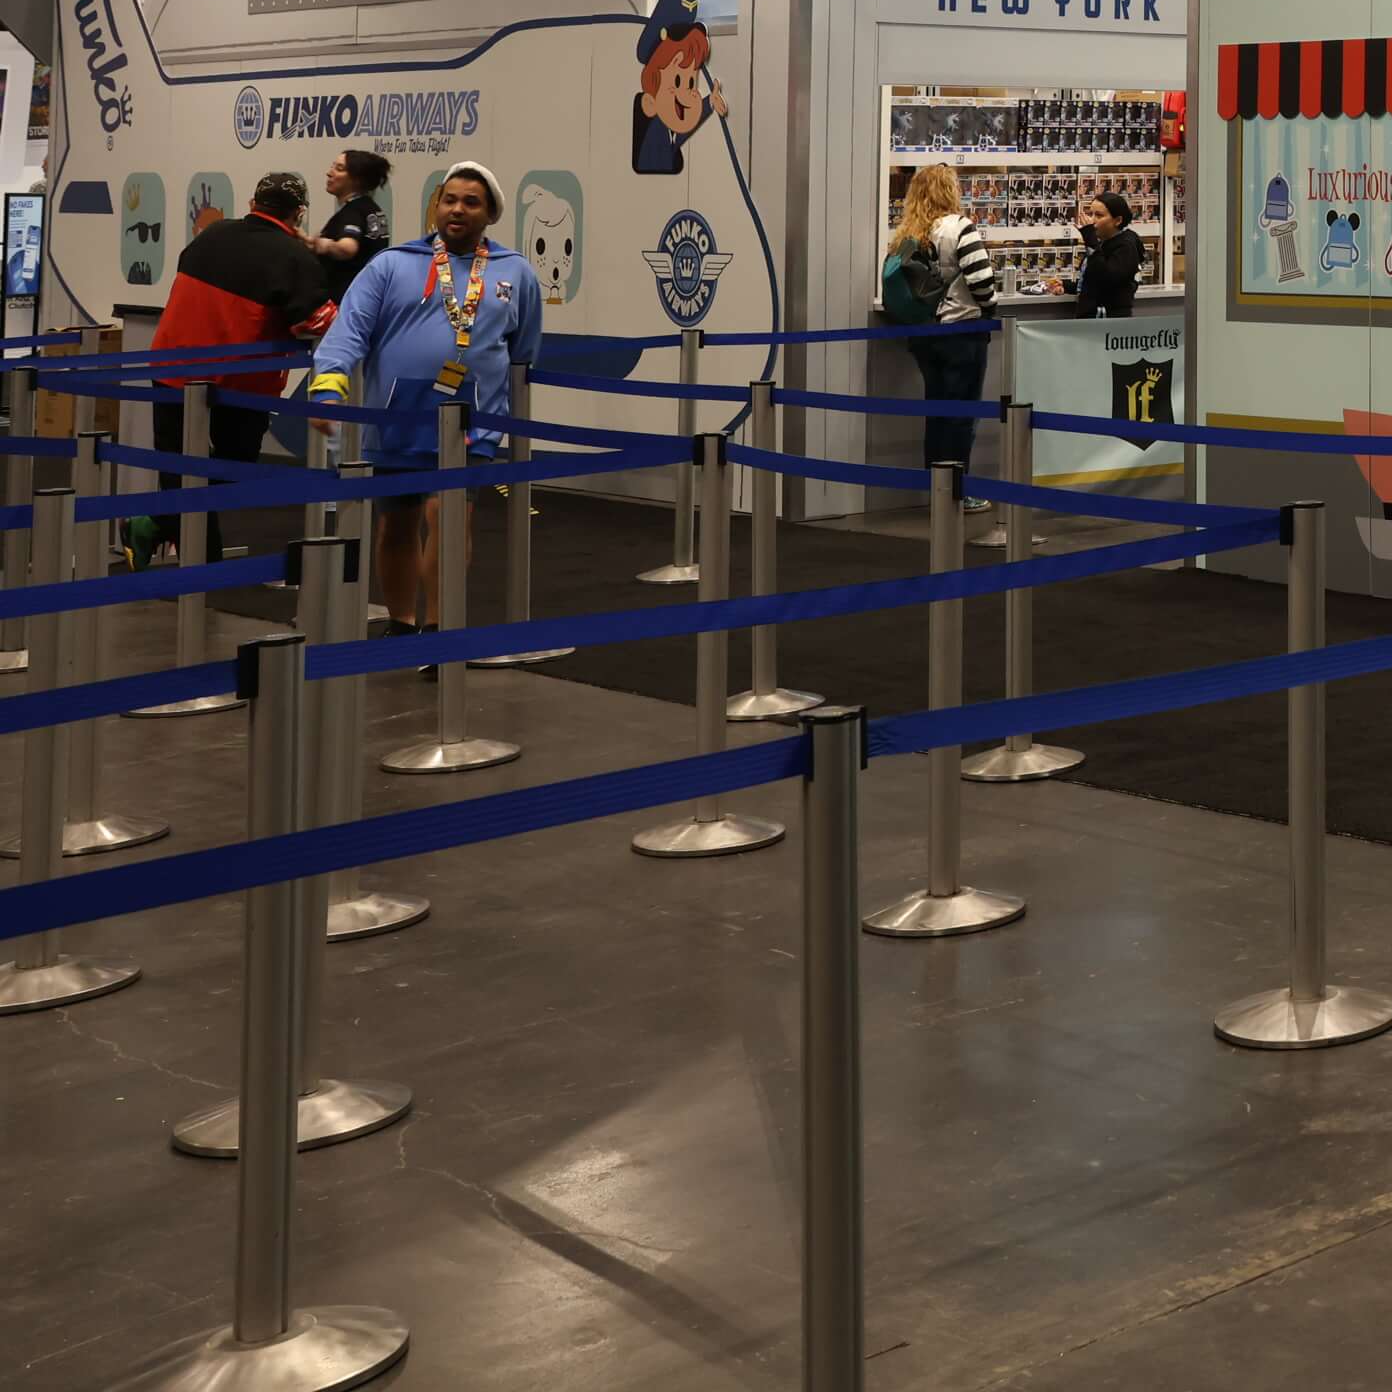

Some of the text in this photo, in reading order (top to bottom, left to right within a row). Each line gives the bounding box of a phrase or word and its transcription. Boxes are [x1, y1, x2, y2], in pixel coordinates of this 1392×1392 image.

[665, 219, 709, 253] FUNKO
[663, 283, 709, 316] AIRWAYS
[1106, 329, 1180, 351] loungefly
